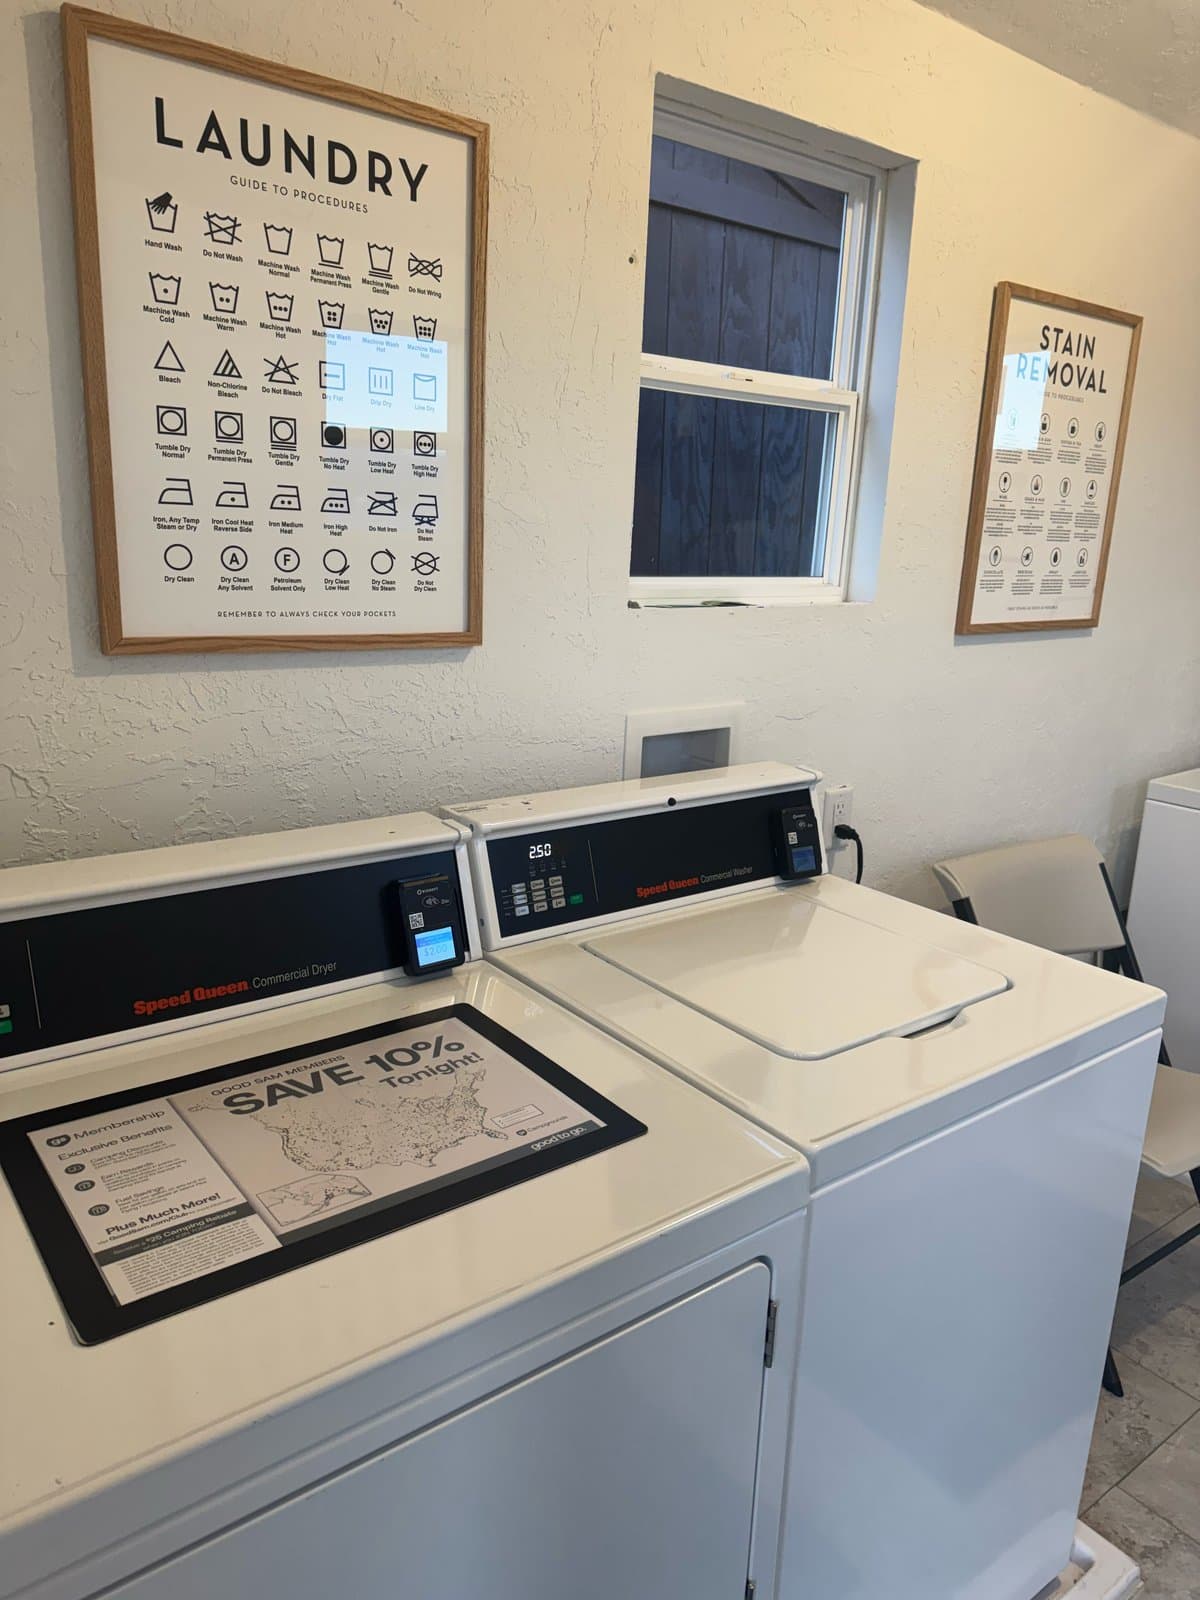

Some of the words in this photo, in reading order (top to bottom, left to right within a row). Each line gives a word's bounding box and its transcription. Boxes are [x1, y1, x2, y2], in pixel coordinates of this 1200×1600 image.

[154, 96, 429, 203] LAUNDRY
[230, 175, 268, 192] GUIDE
[272, 184, 288, 197] TO
[293, 189, 369, 214] PROCEDURES
[144, 239, 164, 250] Hand
[164, 242, 183, 252] Wash
[202, 249, 213, 257] Do
[213, 251, 225, 259] Not
[226, 253, 243, 262] Wash
[258, 259, 283, 271] Machine
[284, 263, 301, 273] Wash
[269, 268, 290, 278] Normal
[311, 269, 335, 278] Machine
[335, 273, 351, 281] Wash
[310, 276, 337, 286] Permanent
[338, 280, 352, 289] Press
[361, 278, 384, 287] Machine
[384, 282, 400, 290] Wash
[372, 287, 390, 295] Gentle
[427, 289, 442, 299] Wring
[143, 305, 171, 316] Machine
[172, 309, 190, 318] Wash
[159, 315, 175, 324] Cold
[203, 314, 229, 325] Machine
[229, 318, 248, 327] Wash
[217, 323, 235, 332] Warm
[259, 322, 285, 332] Machine
[284, 326, 302, 335] Wash
[1039, 324, 1096, 360] STAIN
[158, 375, 181, 384] Bleach
[1016, 352, 1107, 394] REMOVAL
[207, 380, 248, 391] Non-Chlorine
[271, 387, 282, 395] Not
[283, 389, 303, 397] Bleach
[217, 390, 239, 398] Bleach
[155, 443, 179, 452] Tumble
[180, 445, 191, 453] Dry
[236, 449, 247, 457] Dry
[162, 451, 185, 459] Normal
[208, 454, 237, 463] Permanent
[237, 456, 253, 464] Press
[268, 452, 289, 460] Tumble
[290, 453, 300, 461] Dry
[274, 459, 294, 467] Gentle
[183, 517, 200, 525] Temp
[186, 524, 197, 532] Dry
[636, 880, 668, 898] Speed
[668, 876, 699, 890] Queen
[700, 868, 733, 884] Commercial
[733, 866, 753, 876] Washer
[133, 990, 192, 1015] Speed
[192, 979, 249, 1001] Queen
[251, 965, 310, 989] Commercial
[311, 960, 337, 976] Dryer
[210, 1081, 252, 1096] GOOD
[253, 1072, 283, 1084] SAM
[284, 1055, 345, 1077] MEMBERS
[222, 1062, 365, 1116] SAVE
[363, 1034, 465, 1073] 10%
[379, 1051, 485, 1088] Tonight!
[73, 1109, 166, 1140] Membership
[57, 1139, 119, 1161] Exclusive
[120, 1124, 173, 1143] Benefits
[530, 1135, 558, 1151] good
[557, 1131, 570, 1140] to
[104, 1220, 138, 1236] Plus
[138, 1206, 180, 1225] Much
[180, 1192, 222, 1211] More!
